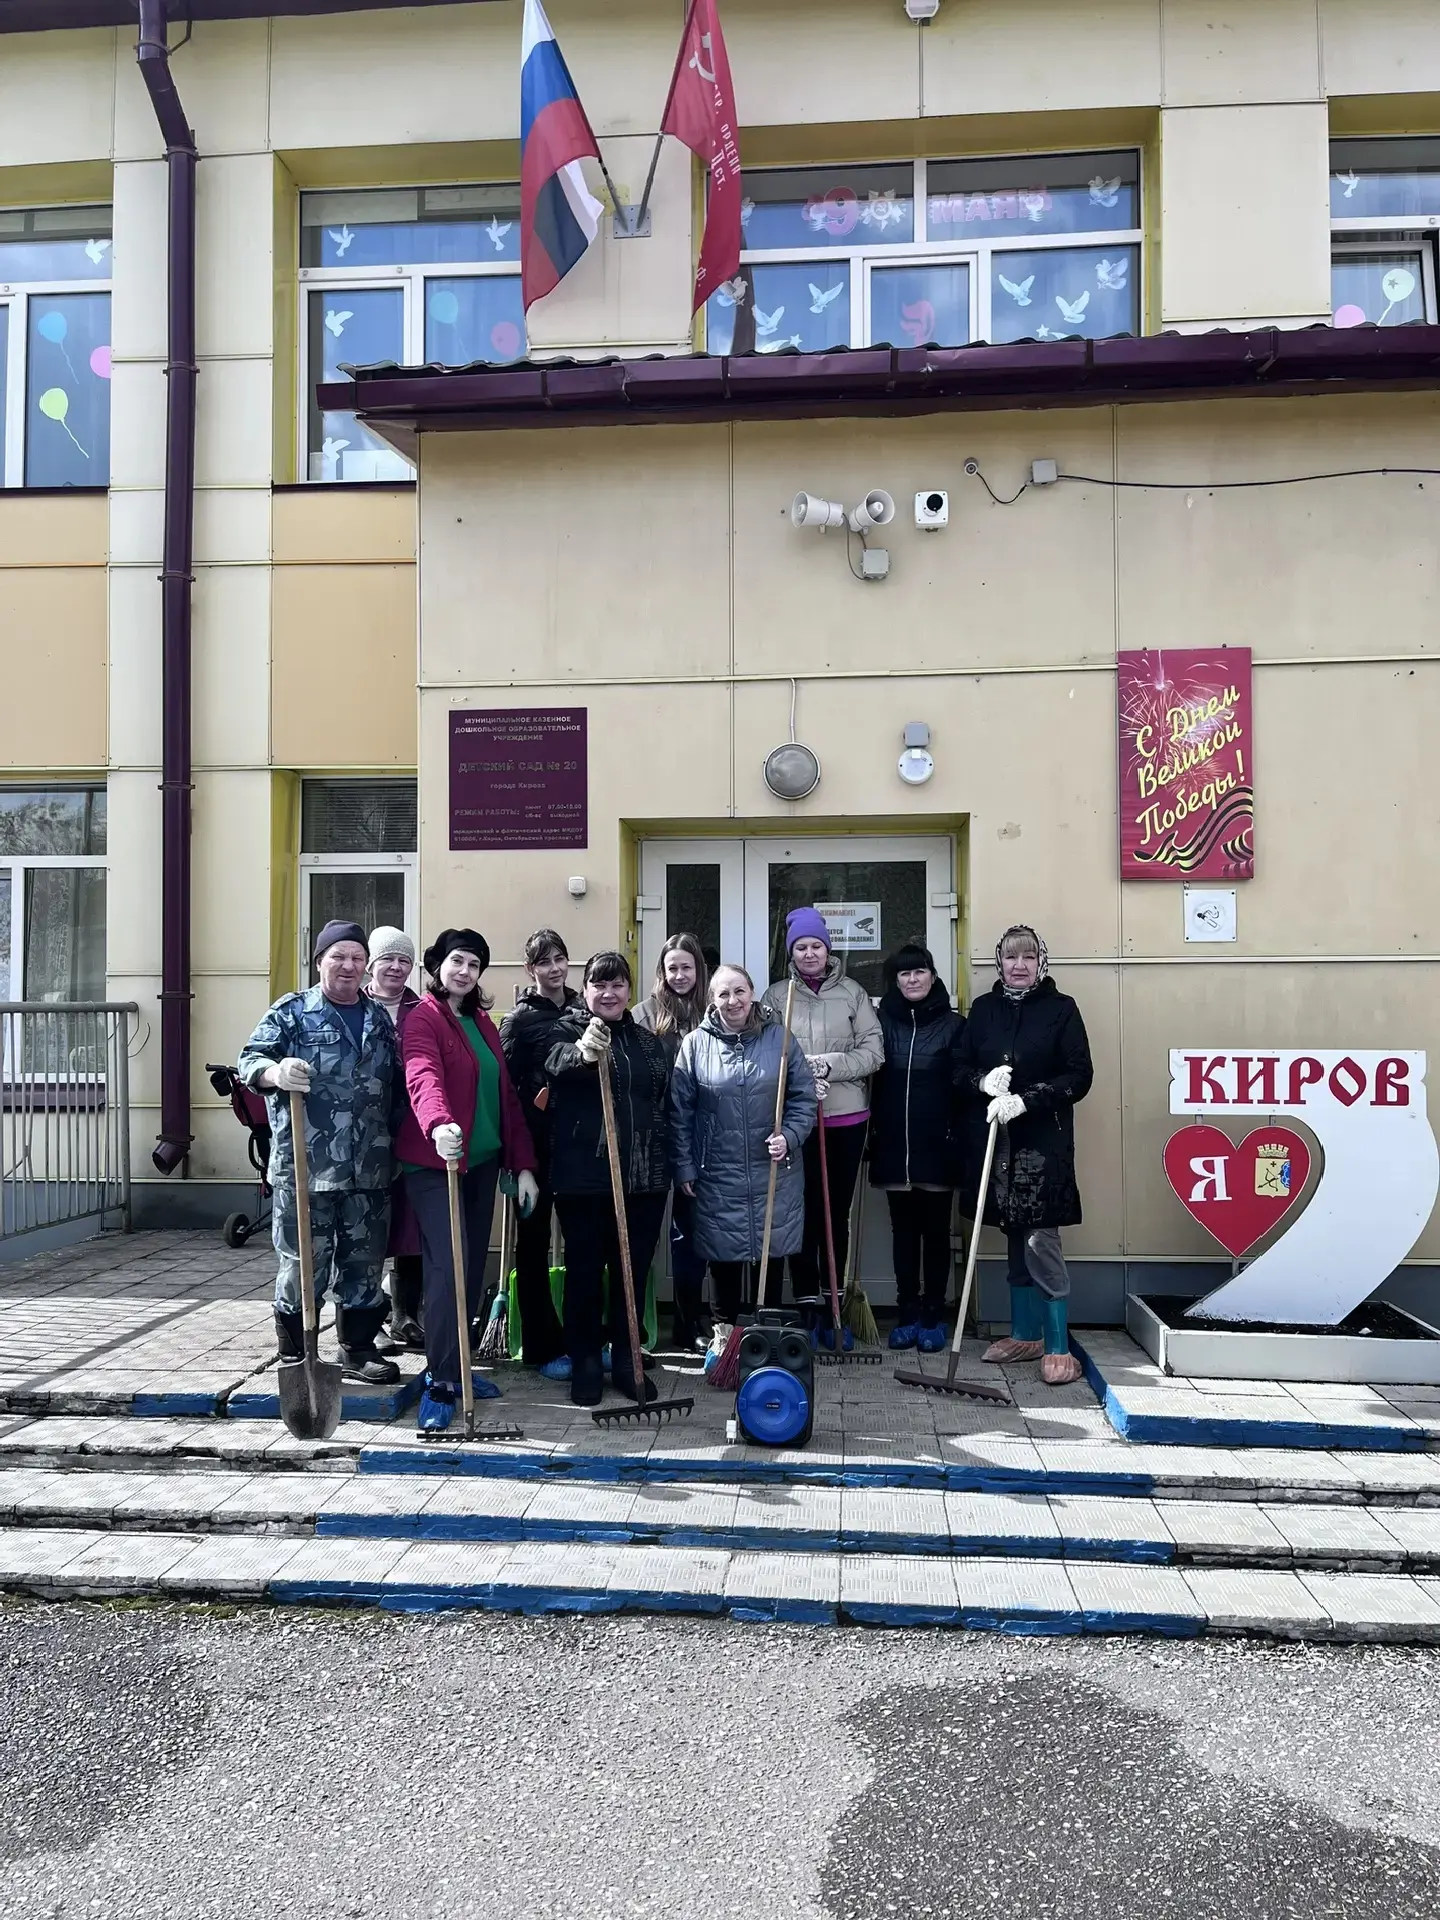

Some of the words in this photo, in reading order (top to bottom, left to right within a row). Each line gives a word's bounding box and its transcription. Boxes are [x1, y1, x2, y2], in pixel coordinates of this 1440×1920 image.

[823, 185, 858, 236] 9
[454, 726, 507, 734] ДОШКОЛЬНОЕ
[464, 716, 530, 724] МУНИЦИПАЛЬНОЕ
[1136, 725, 1157, 759] С
[1166, 684, 1241, 743] Днем
[458, 759, 515, 773] ДЕТСКИЙ
[518, 761, 543, 772] САД
[563, 760, 577, 770] 20
[1138, 711, 1243, 799] Великой
[1184, 1055, 1410, 1108] КИРОВ
[1188, 1155, 1232, 1203] Я
